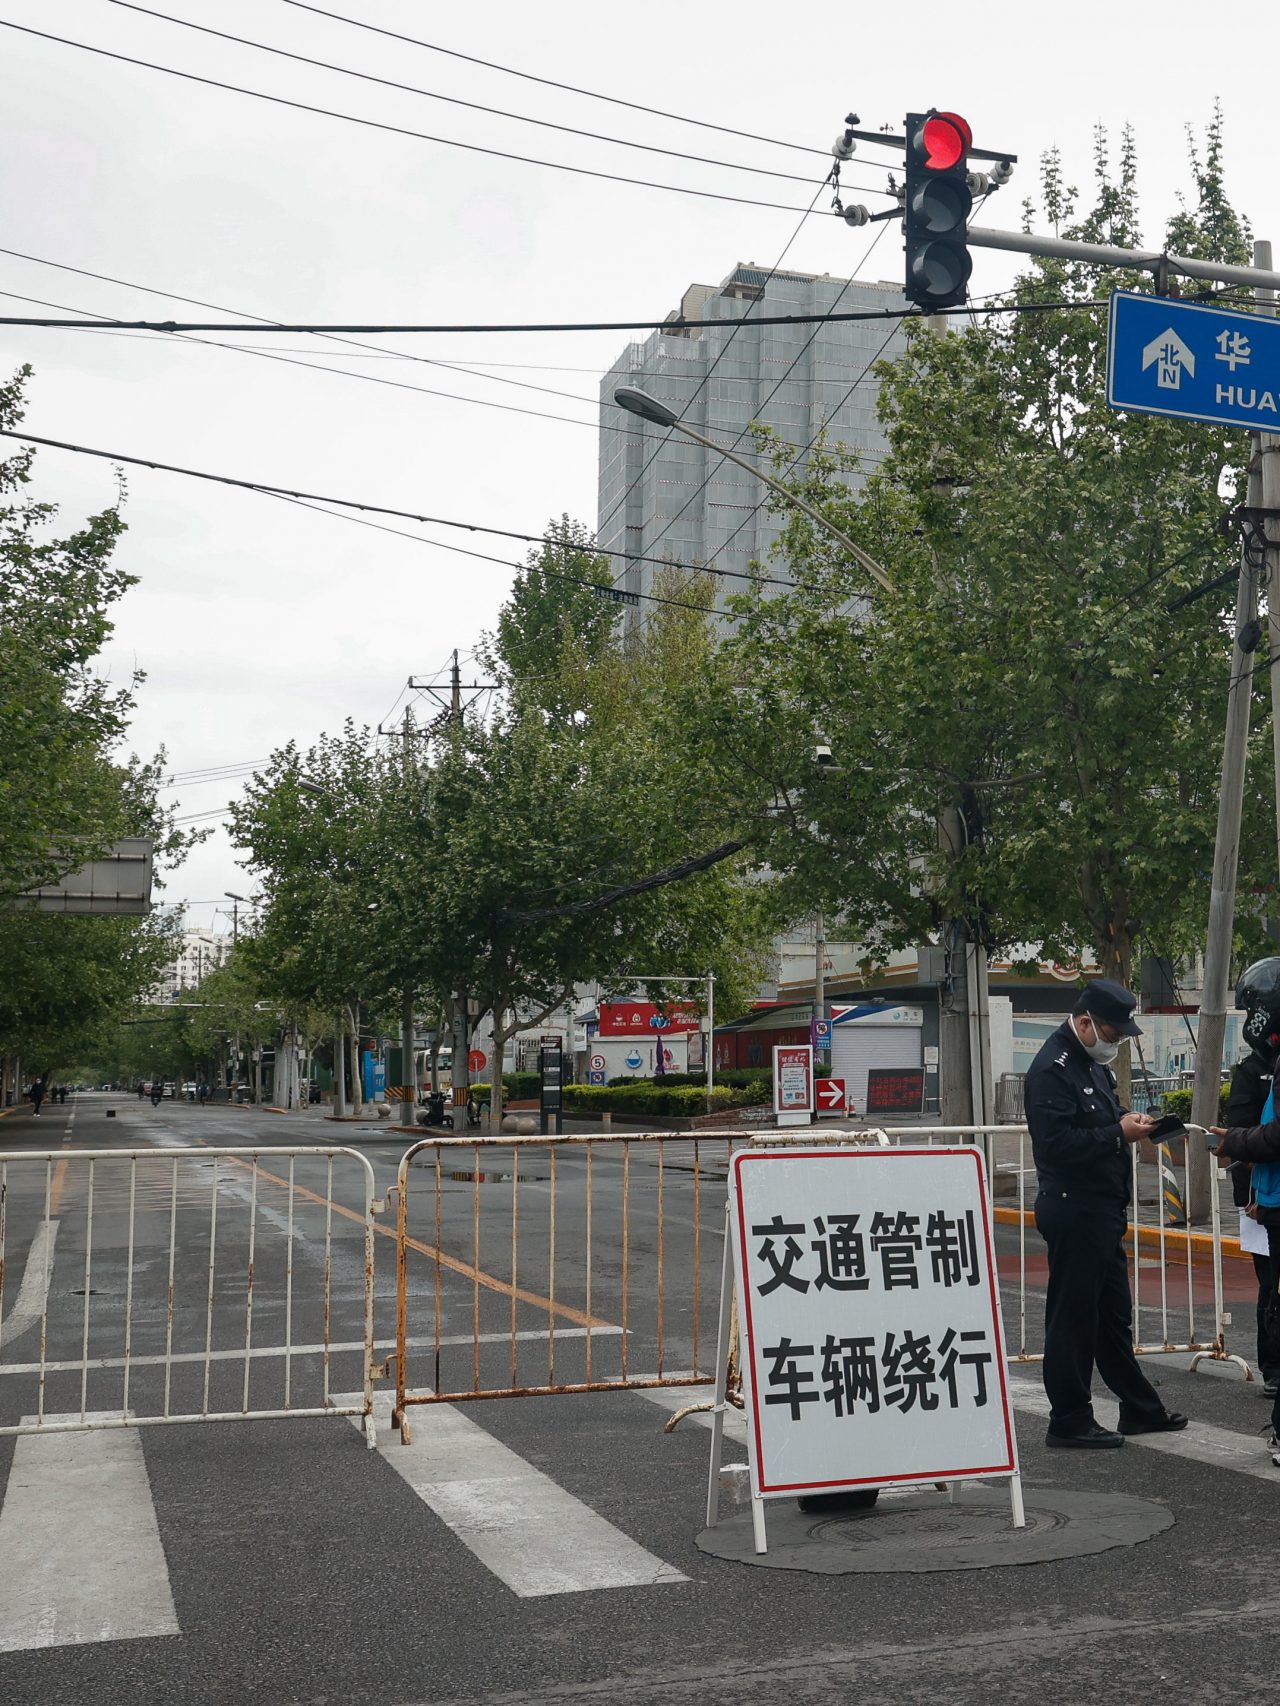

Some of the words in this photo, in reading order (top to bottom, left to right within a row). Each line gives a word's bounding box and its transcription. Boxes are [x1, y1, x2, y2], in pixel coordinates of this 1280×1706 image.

[1160, 343, 1180, 366] 北
[1163, 368, 1176, 384] N
[594, 1058, 602, 1068] 5
[752, 1209, 981, 1297] 交通管制
[762, 1327, 992, 1421] 车辆绕行
